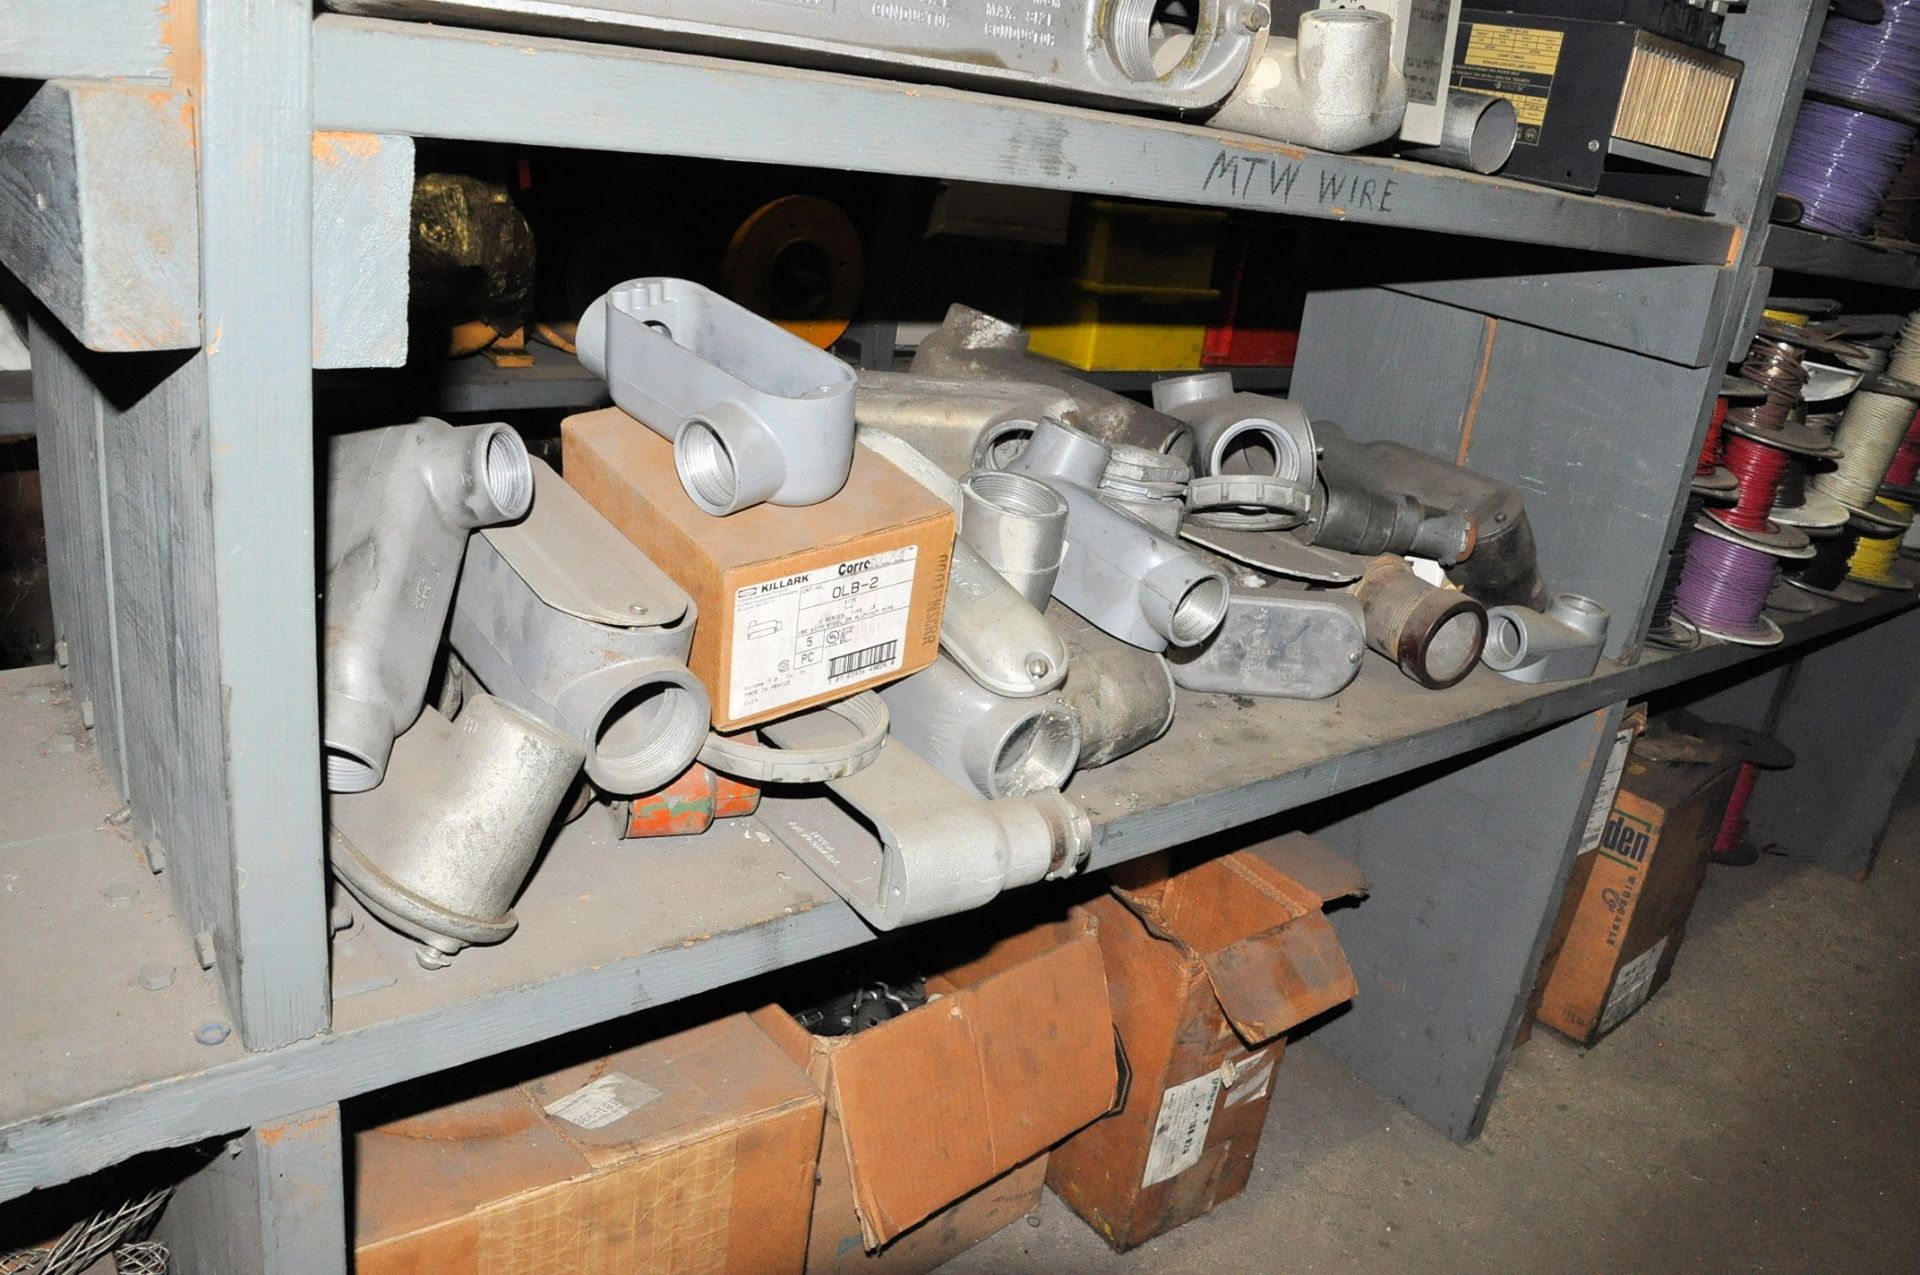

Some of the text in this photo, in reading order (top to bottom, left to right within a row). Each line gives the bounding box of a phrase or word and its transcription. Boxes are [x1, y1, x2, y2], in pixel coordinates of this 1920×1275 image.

[1202, 150, 1399, 213] MTW WIRE
[761, 574, 809, 593] KILLARK
[832, 576, 879, 599] OLB-2
[806, 635, 814, 648] 5
[801, 651, 814, 665] PC
